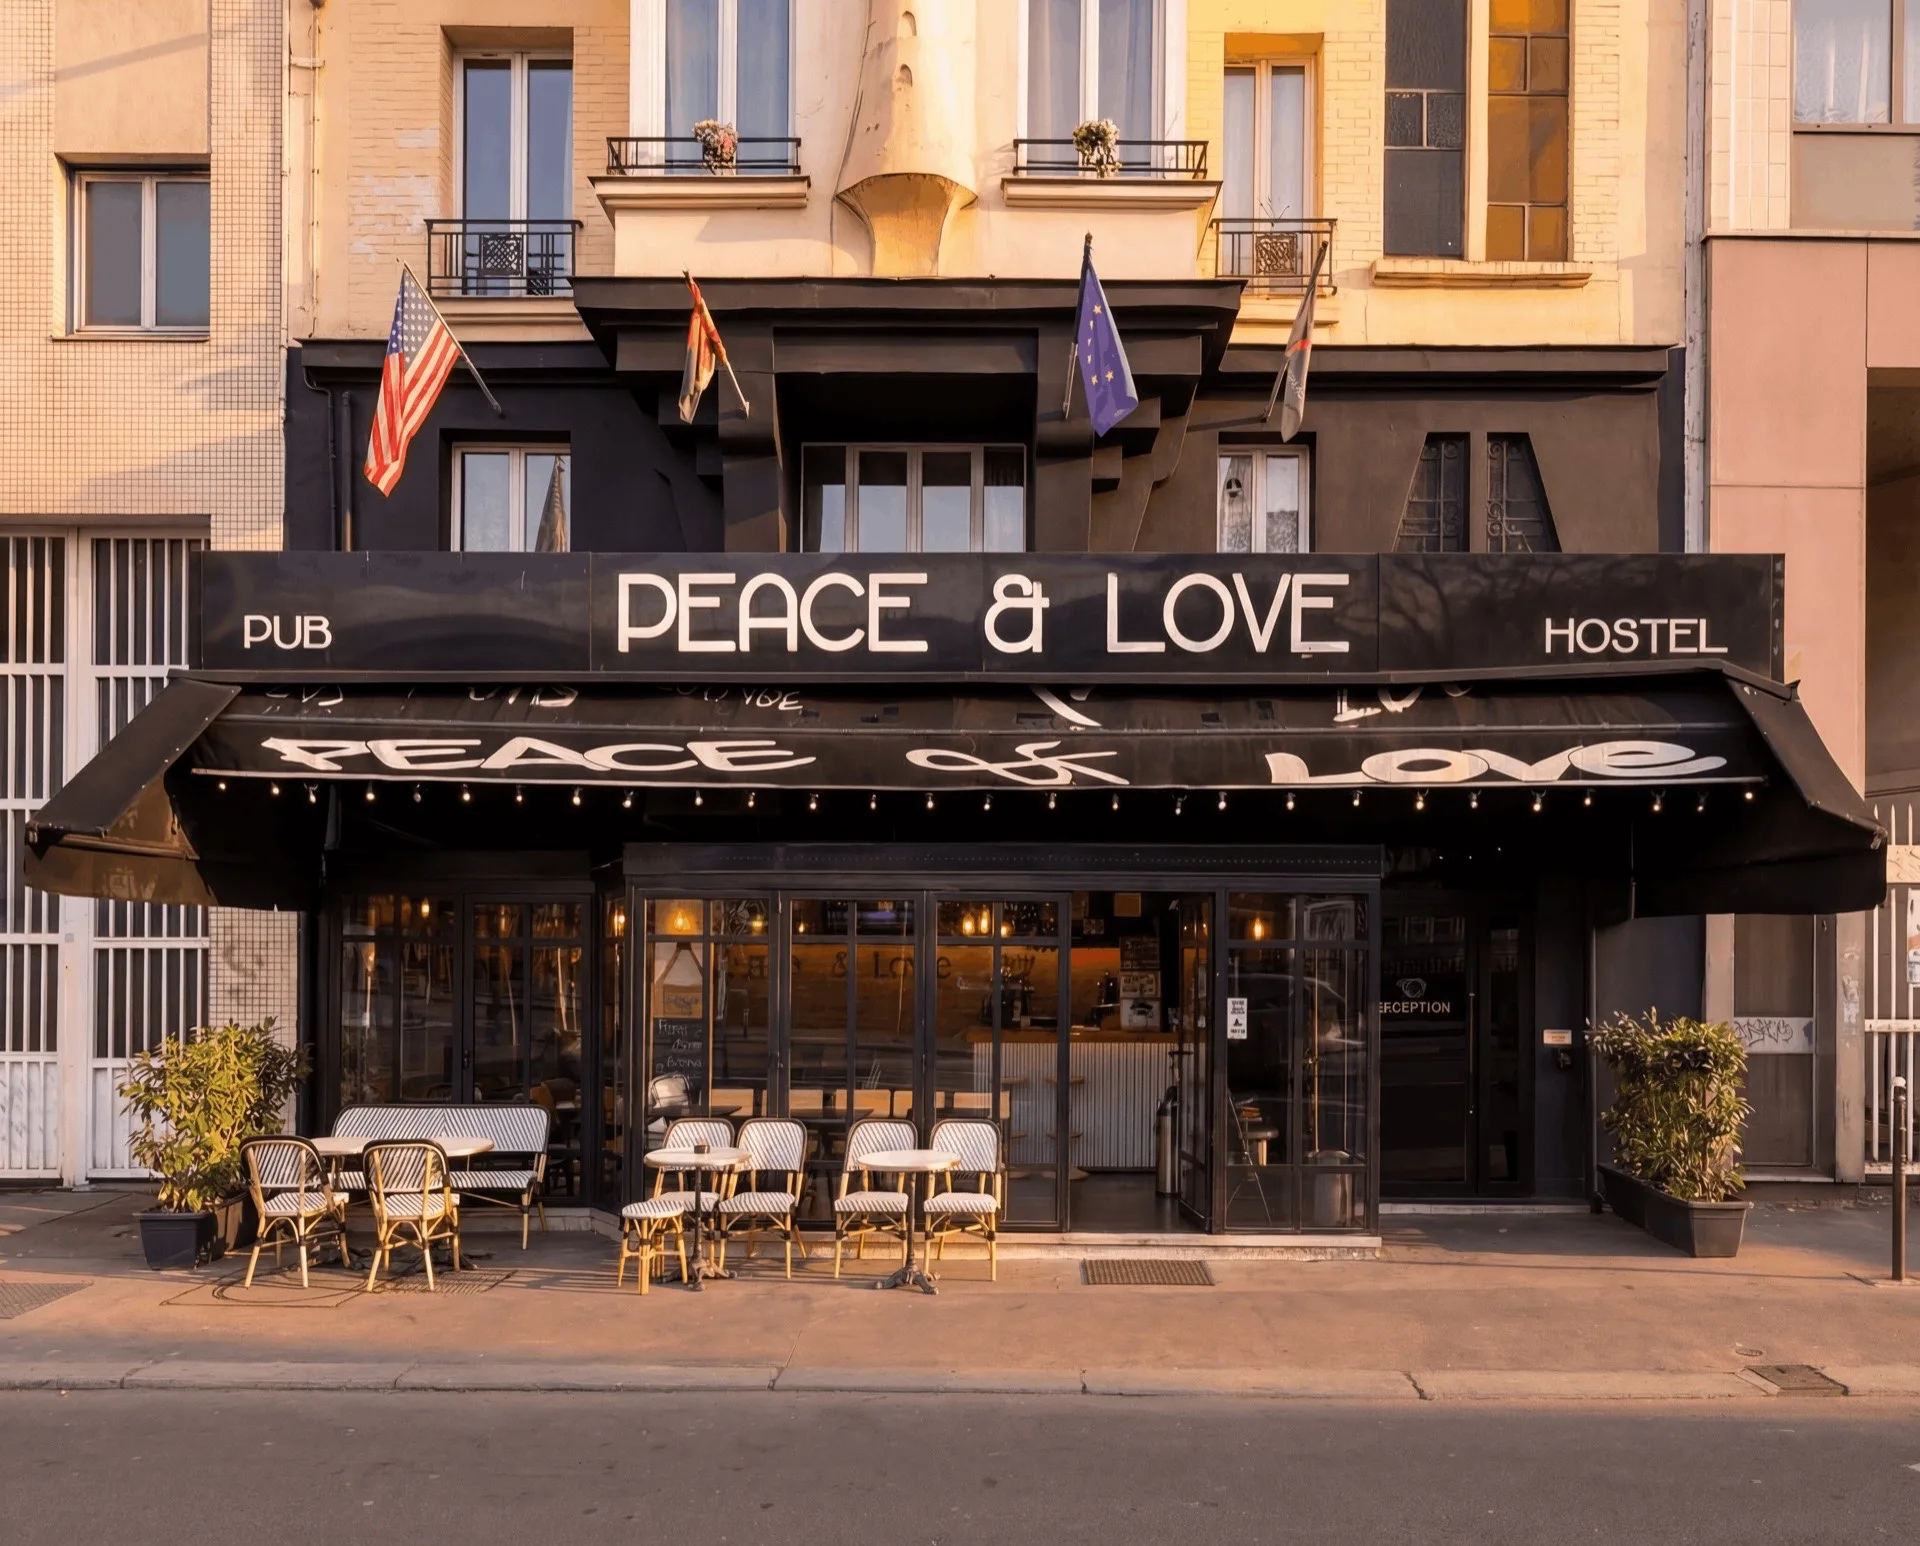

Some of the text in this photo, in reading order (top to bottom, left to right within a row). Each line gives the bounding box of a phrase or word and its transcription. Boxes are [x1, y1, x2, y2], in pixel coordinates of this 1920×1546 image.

[243, 613, 333, 650] PUB
[617, 571, 1350, 655] PEACE & LOVE
[1544, 616, 1729, 655] HOSTEL
[260, 735, 817, 773] PEACE
[905, 739, 1131, 786] &
